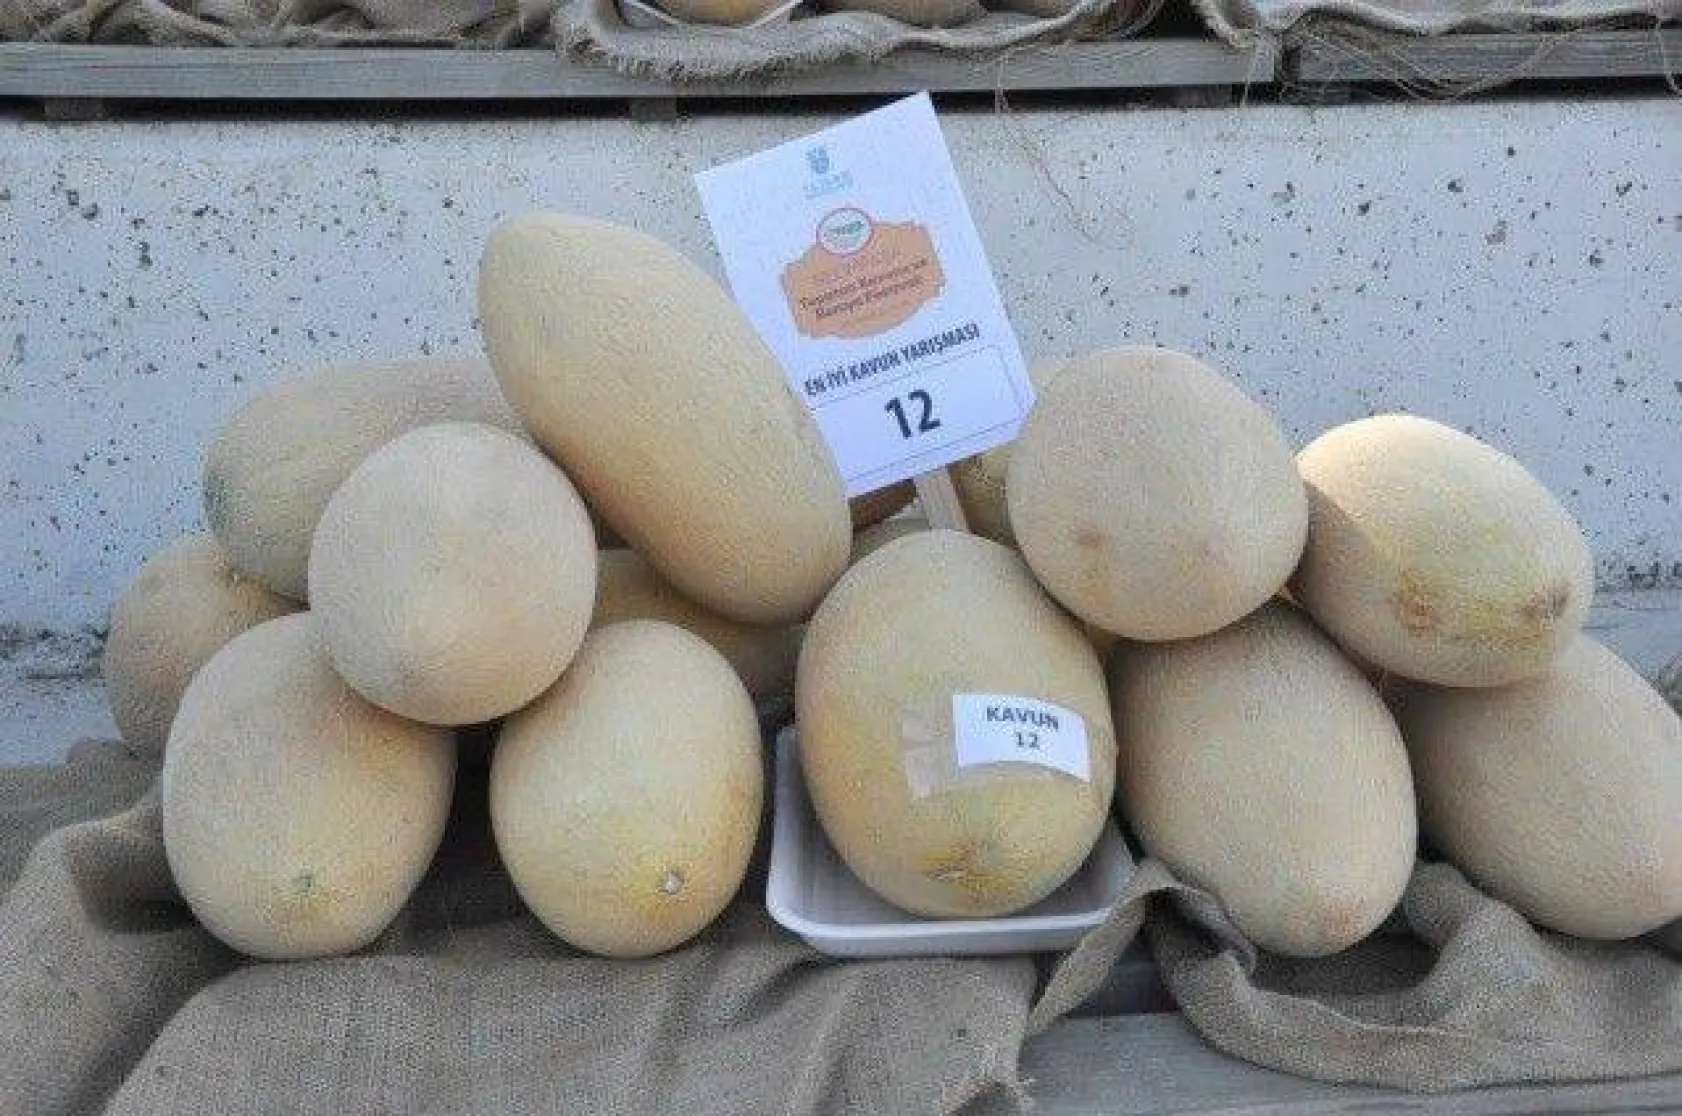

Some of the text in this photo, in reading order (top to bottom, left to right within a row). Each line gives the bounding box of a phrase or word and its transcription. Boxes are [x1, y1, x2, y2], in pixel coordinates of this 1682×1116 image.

[805, 377, 827, 396] EN
[850, 350, 901, 380] KAVUN
[885, 389, 941, 438] 12
[986, 706, 1059, 732] KAVUN
[1016, 731, 1041, 750] 12
